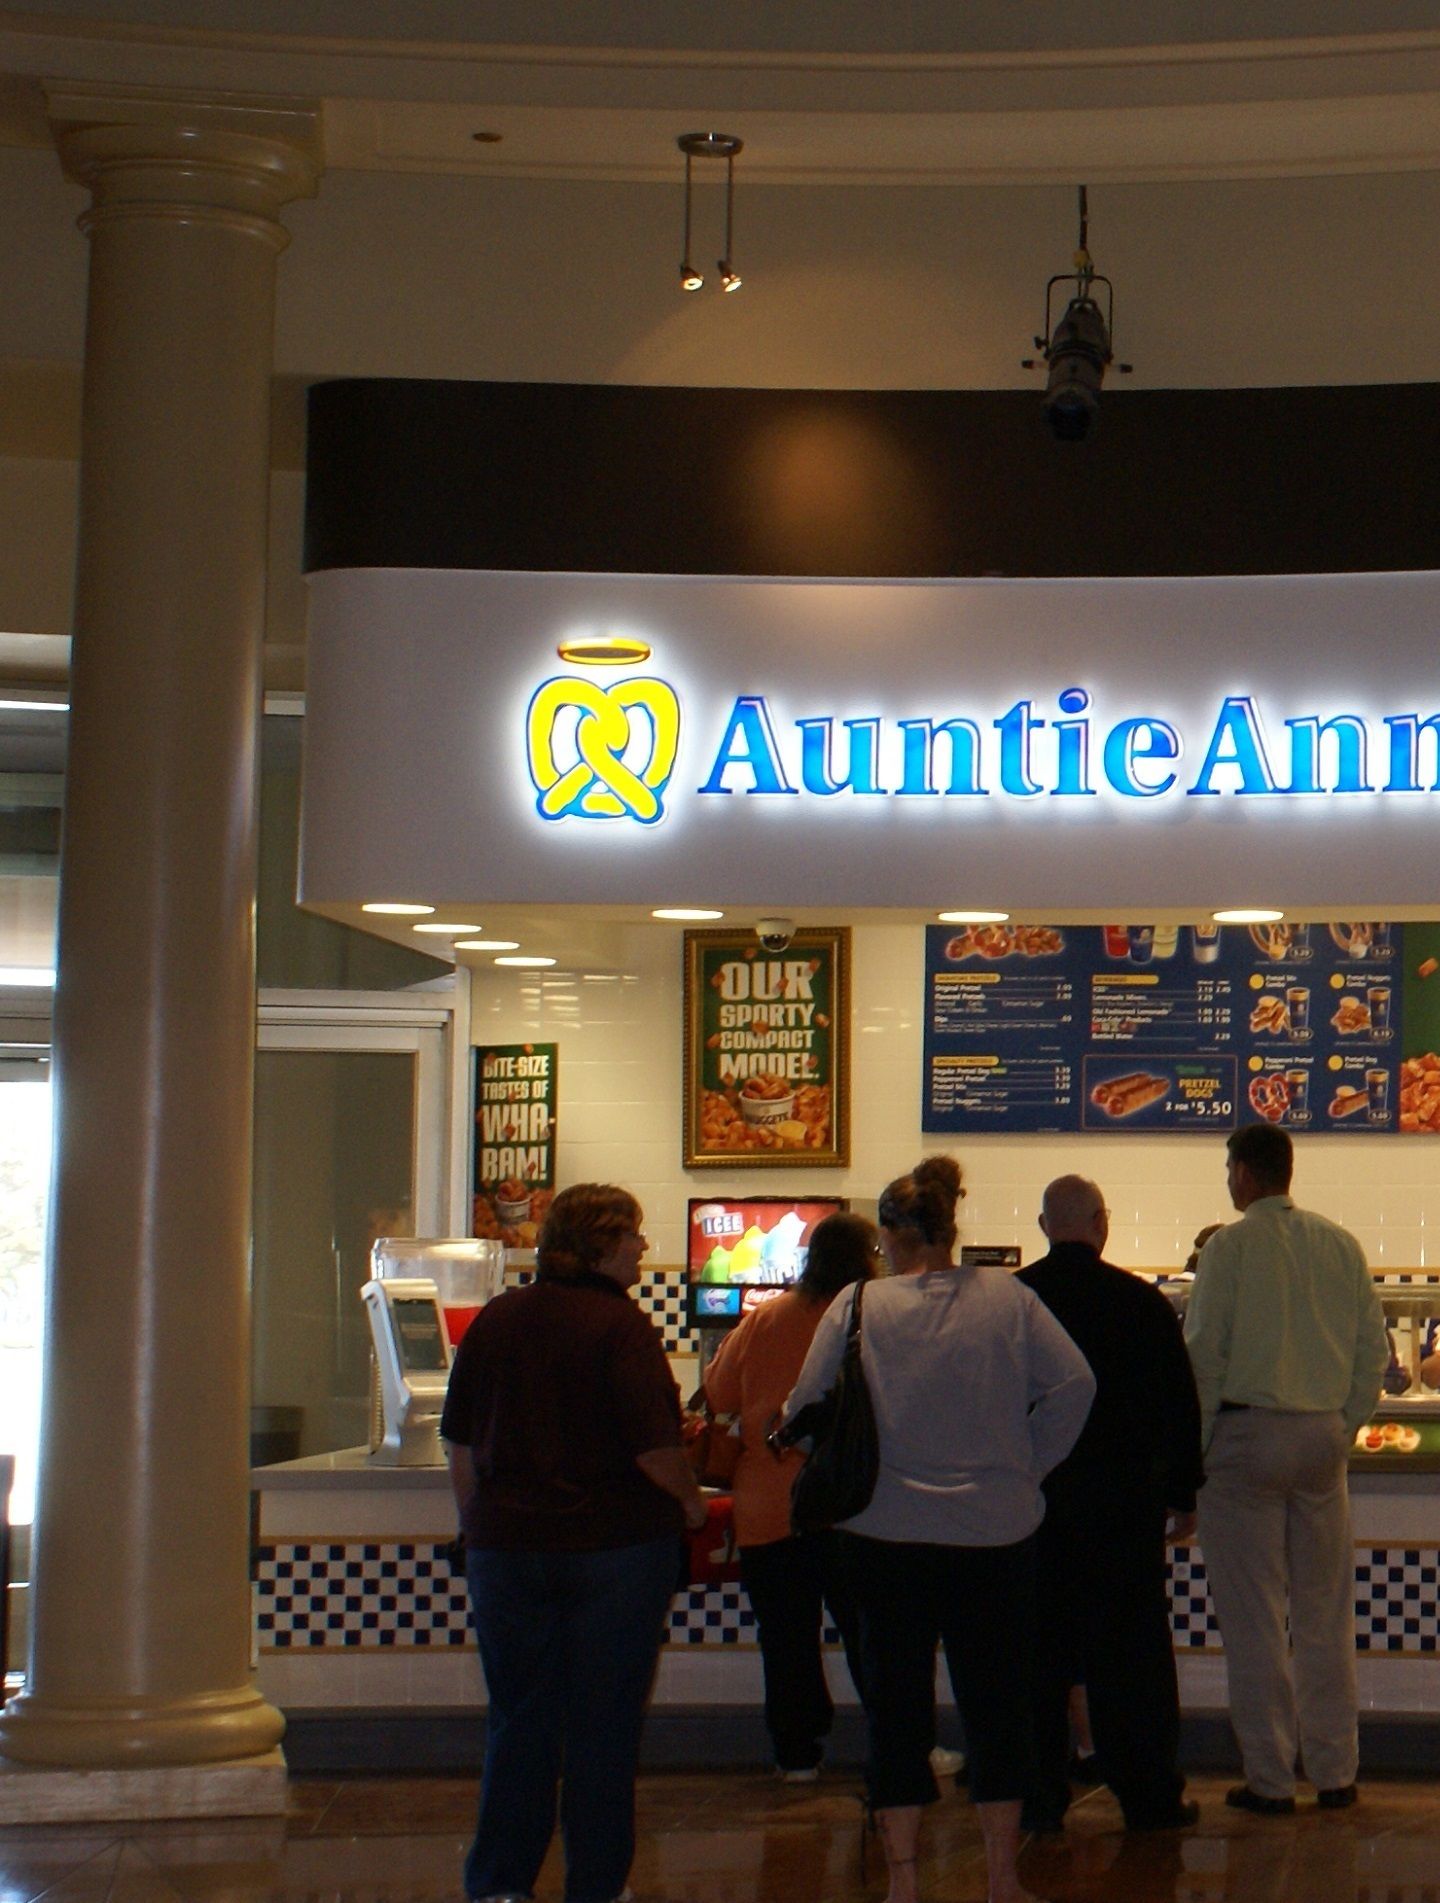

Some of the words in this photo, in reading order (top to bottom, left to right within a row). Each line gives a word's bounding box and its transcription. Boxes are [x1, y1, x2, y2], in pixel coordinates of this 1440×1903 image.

[697, 687, 1180, 797] Auntie
[720, 961, 815, 1000] OUR
[720, 1003, 815, 1028] SPORTY
[719, 1030, 815, 1050] COMPACT
[483, 1054, 550, 1078] BITE-SIZE
[719, 1053, 819, 1079] MODEL.
[482, 1081, 530, 1101] TASTES
[532, 1080, 549, 1099] OF
[1179, 1078, 1221, 1089] PRETZEL
[1185, 1088, 1213, 1099] DOGS
[1165, 1101, 1173, 1112] 2
[481, 1145, 548, 1181] BAM!
[703, 1214, 742, 1234] ICEE
